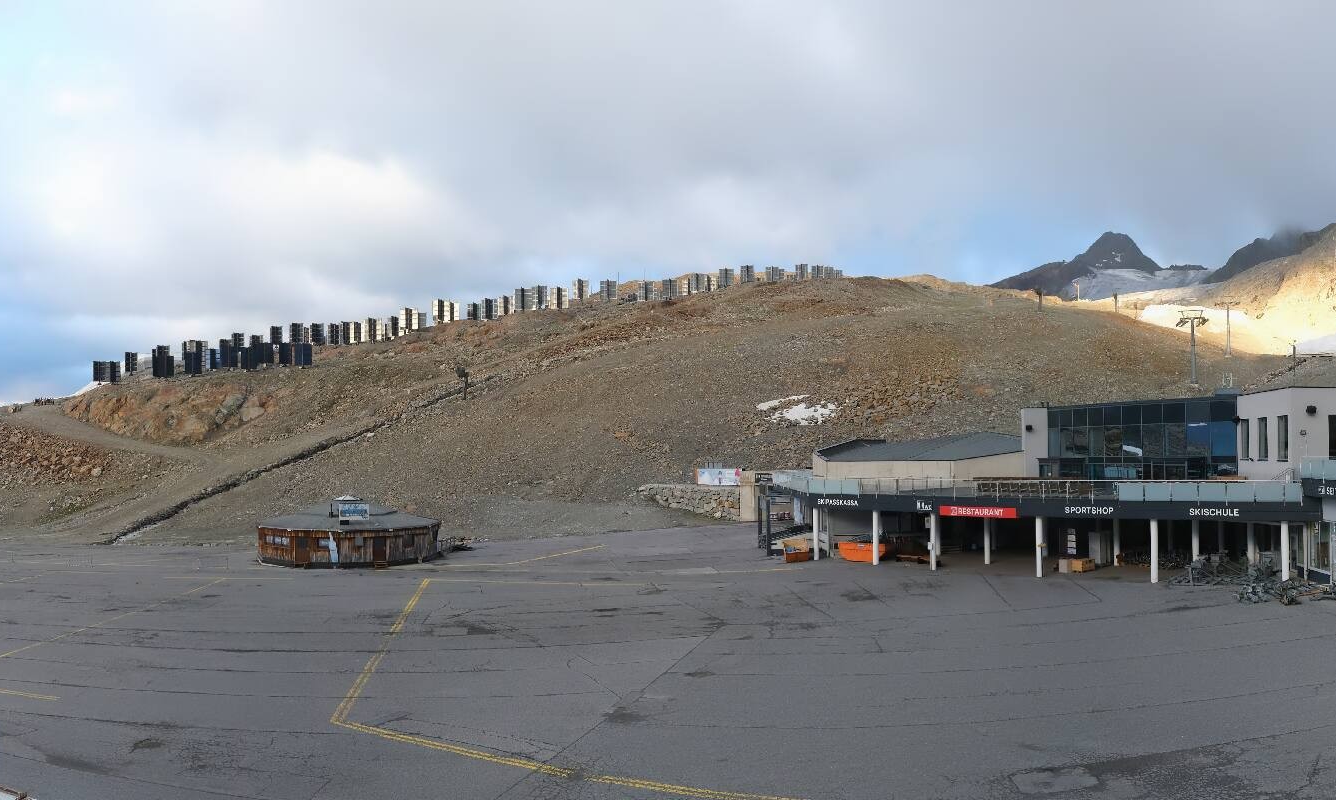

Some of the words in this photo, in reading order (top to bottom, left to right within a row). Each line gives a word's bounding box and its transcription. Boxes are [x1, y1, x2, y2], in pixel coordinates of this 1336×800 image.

[957, 507, 1004, 517] RESTAURANT
[1064, 506, 1114, 515] SPORTSHOP
[1189, 507, 1240, 517] SKISCHULE
